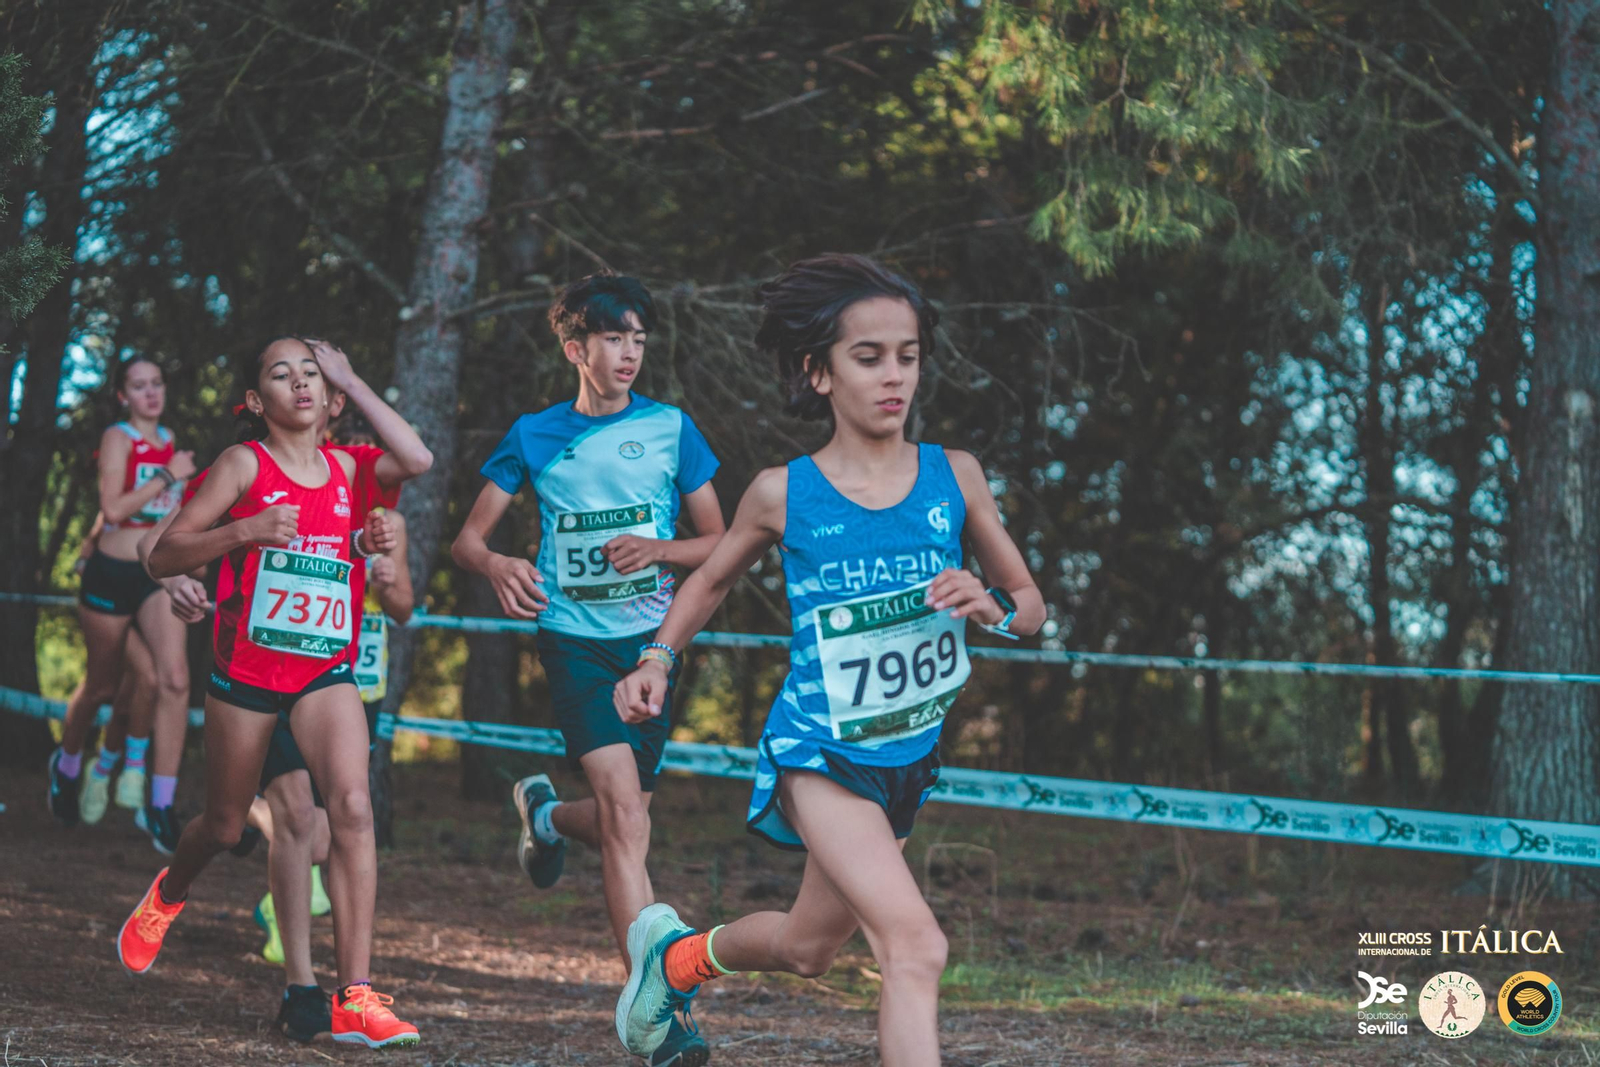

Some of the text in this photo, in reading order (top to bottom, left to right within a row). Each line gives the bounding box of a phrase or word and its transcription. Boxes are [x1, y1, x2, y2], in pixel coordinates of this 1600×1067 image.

[812, 523, 844, 538] vive
[295, 556, 337, 575] ITÁLICA
[567, 545, 610, 578] 59
[267, 587, 345, 630] 7370
[862, 588, 928, 623] ITÁLIC
[839, 630, 958, 707] 7969
